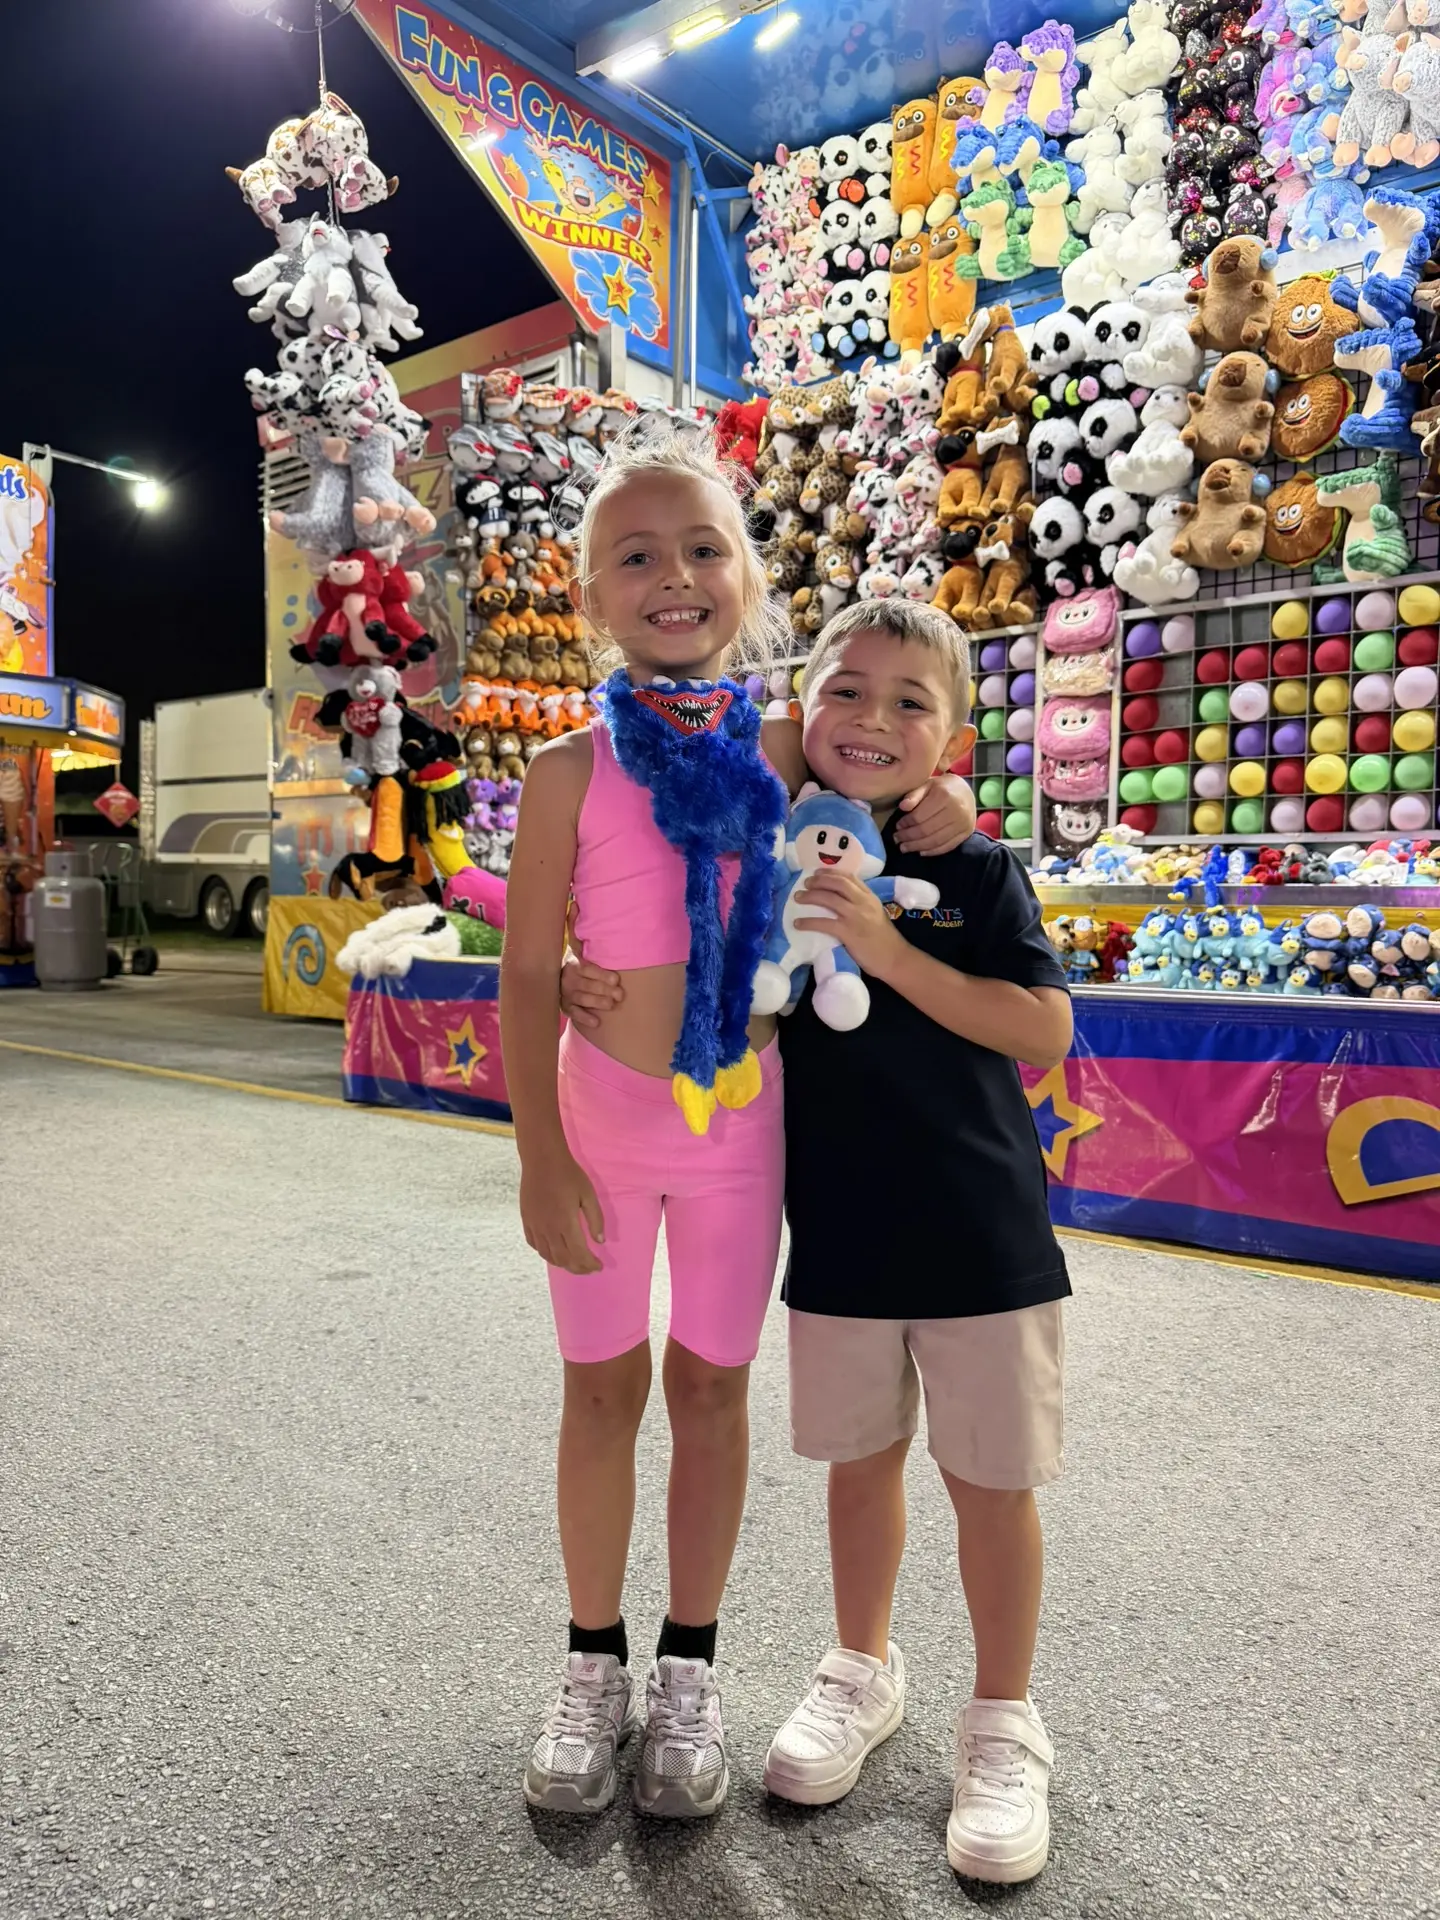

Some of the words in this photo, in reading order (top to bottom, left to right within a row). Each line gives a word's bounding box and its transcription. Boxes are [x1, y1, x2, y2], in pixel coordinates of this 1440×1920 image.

[396, 5, 486, 105] FUN
[487, 74, 521, 124] &
[519, 81, 649, 188] GAMES
[515, 199, 653, 268] WINNER
[933, 920, 964, 929] ACADEMY
